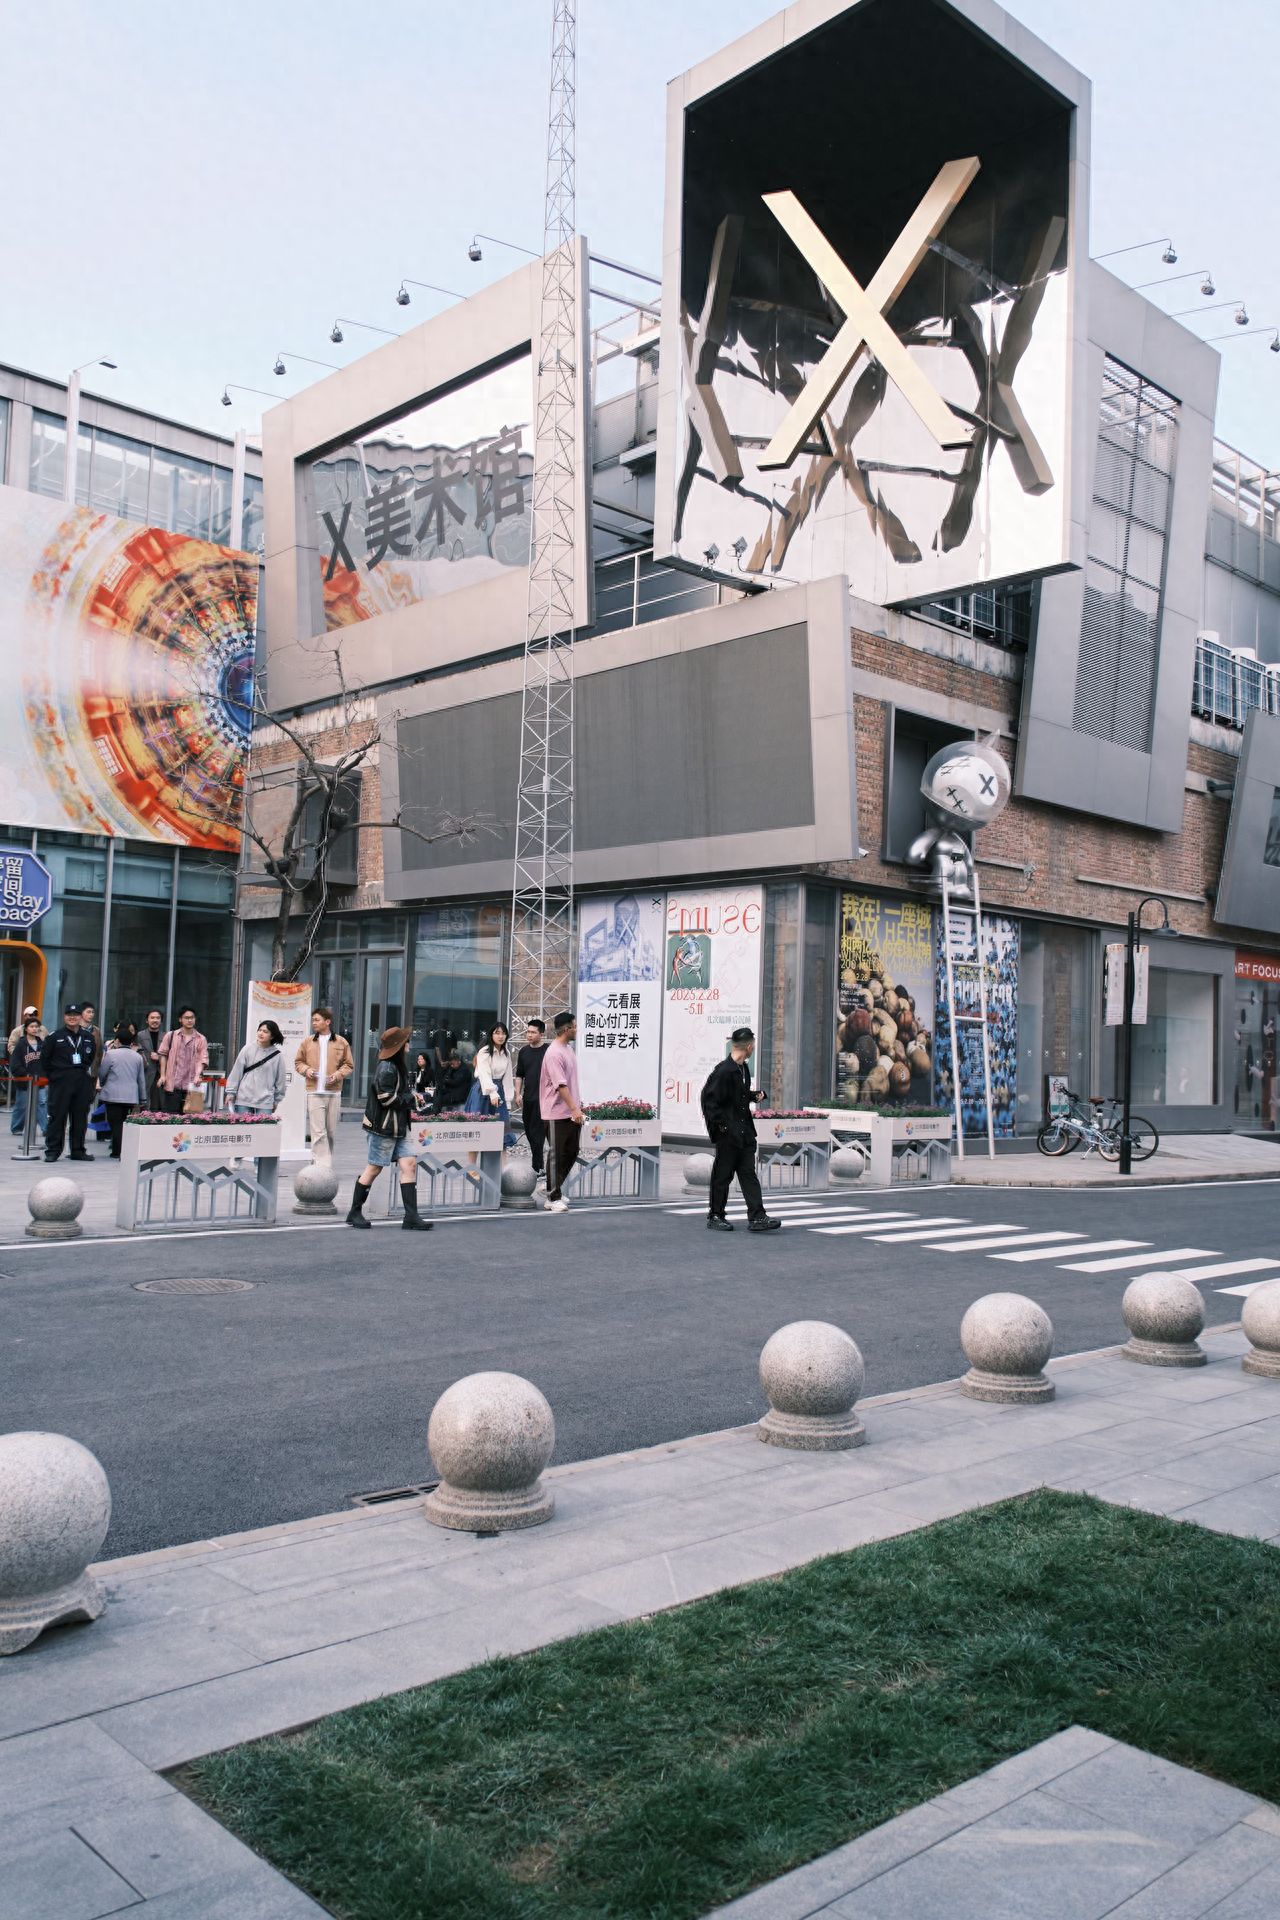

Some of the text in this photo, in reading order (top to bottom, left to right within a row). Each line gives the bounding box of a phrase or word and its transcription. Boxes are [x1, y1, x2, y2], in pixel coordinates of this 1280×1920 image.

[3, 890, 43, 911] Stay
[345, 893, 382, 909] MUSEUM
[852, 918, 878, 938] AM
[885, 920, 932, 943] HERE!
[670, 988, 719, 1001] 2025.2.28
[585, 1013, 640, 1029] 随心付门票
[585, 1033, 639, 1049] 自由享艺术
[194, 1134, 252, 1144] 北京国际电影节
[435, 1130, 481, 1139] 北京国际电影节
